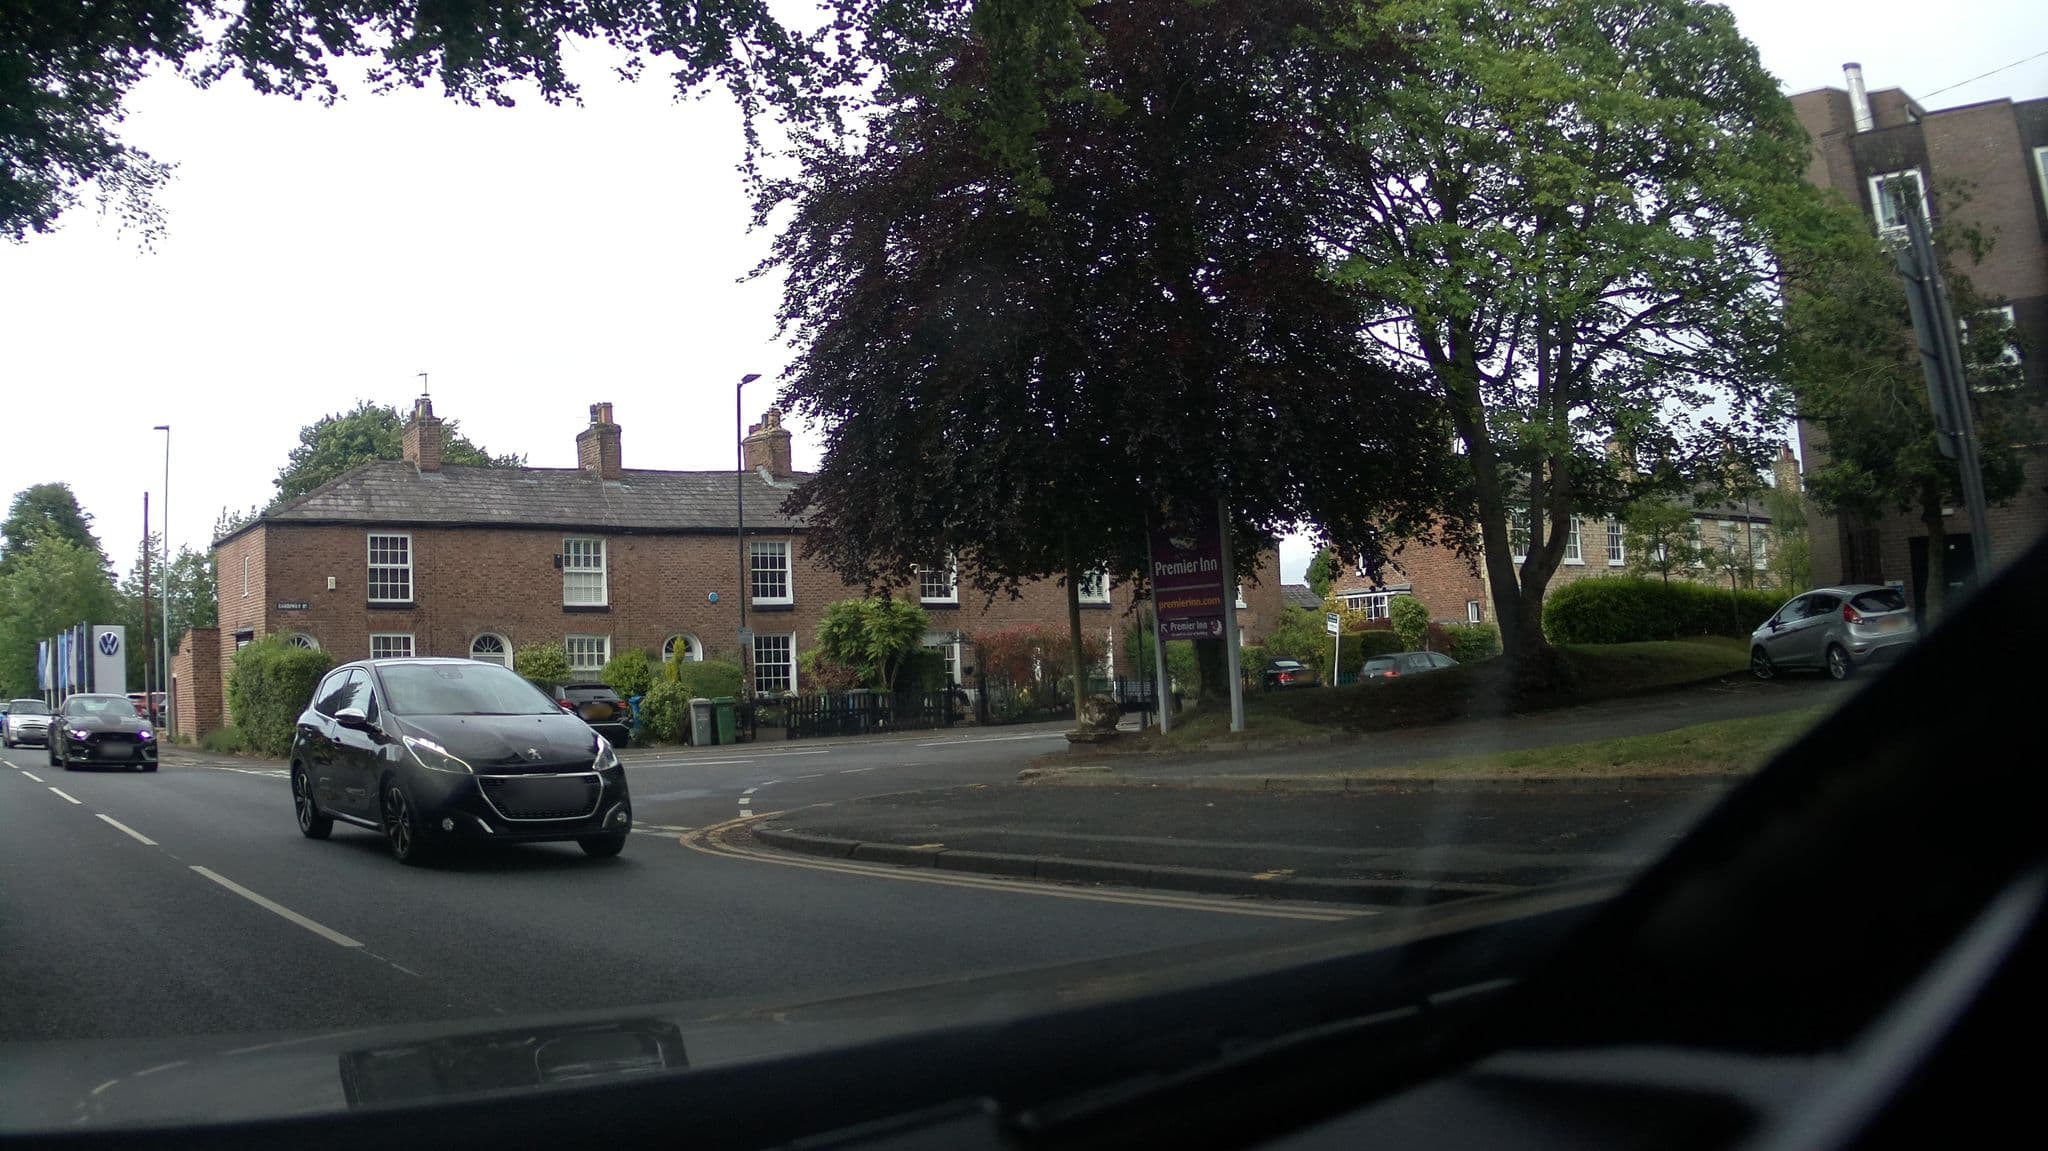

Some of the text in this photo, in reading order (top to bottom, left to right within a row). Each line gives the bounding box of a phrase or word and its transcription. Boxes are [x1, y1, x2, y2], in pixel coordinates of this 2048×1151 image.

[1155, 557, 1217, 576] Premier Inn
[1158, 597, 1220, 612] premierinn.com
[1170, 620, 1208, 631] Premier Inn
